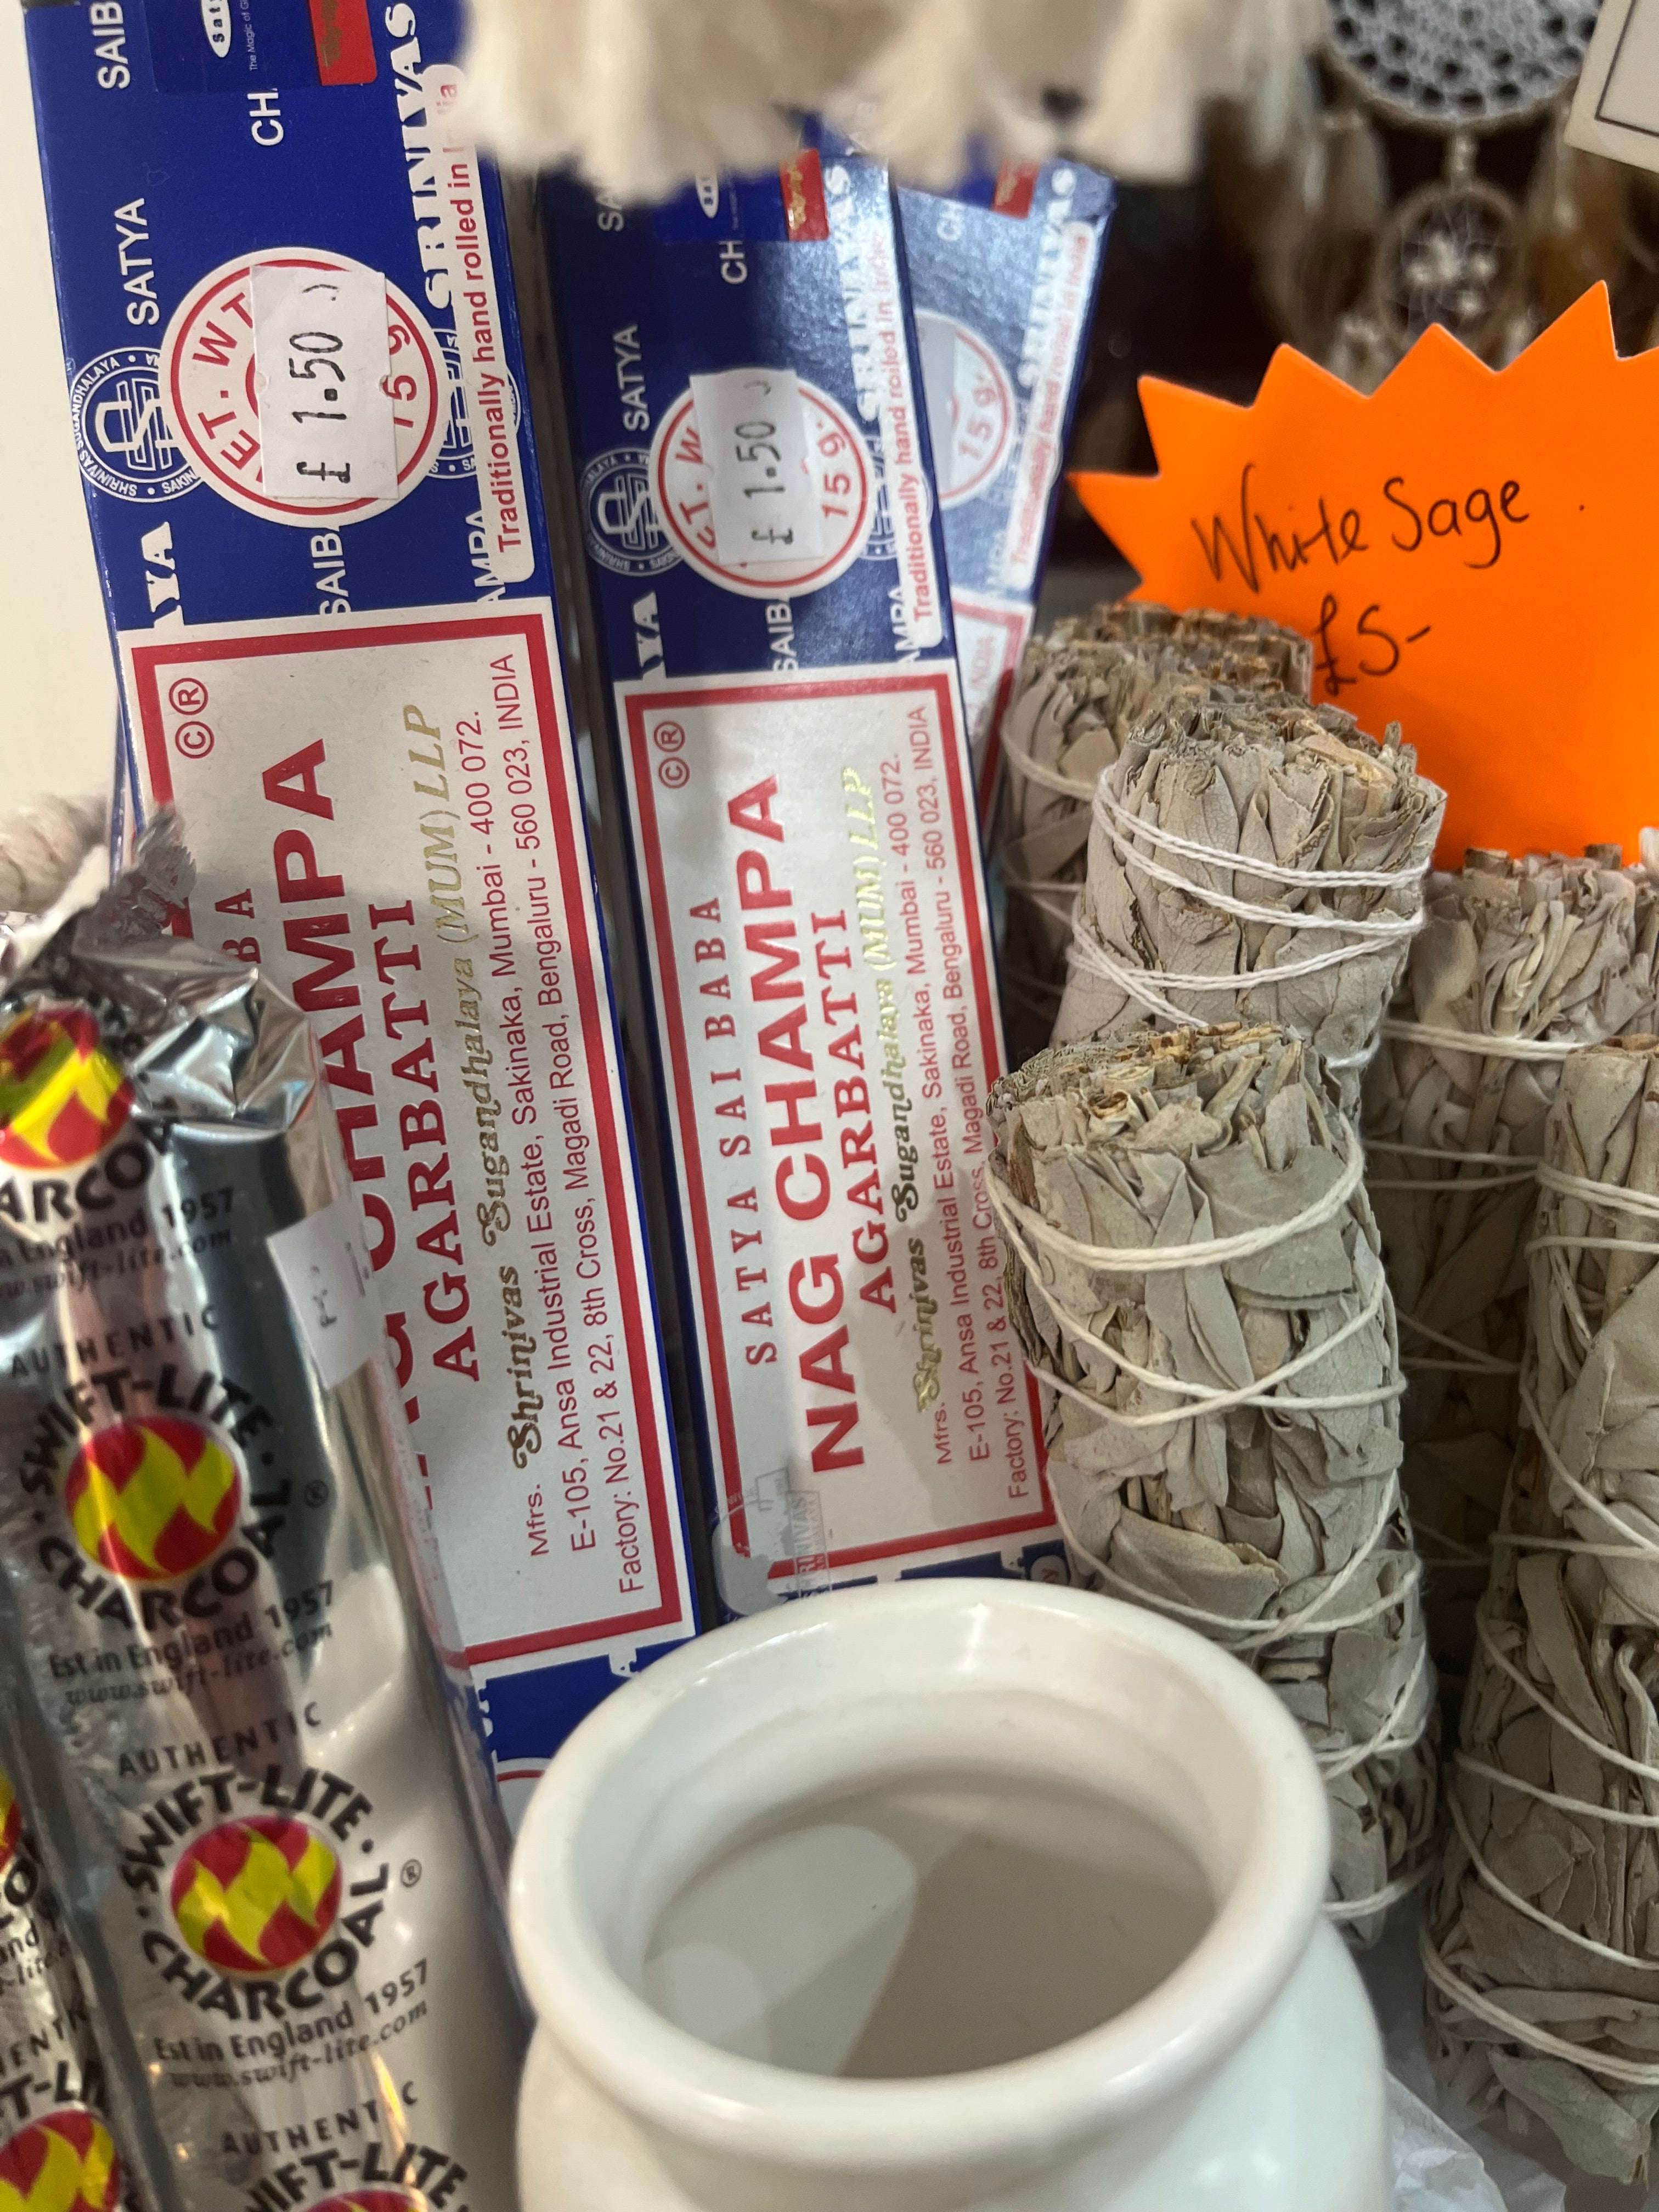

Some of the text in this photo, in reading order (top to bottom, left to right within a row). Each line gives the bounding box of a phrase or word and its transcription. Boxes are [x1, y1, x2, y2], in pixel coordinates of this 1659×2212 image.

[208, 0, 225, 43] Sat
[245, 24, 256, 53] Magic
[250, 52, 258, 71] The
[247, 89, 284, 146] CH
[115, 198, 160, 325] SATYA
[439, 84, 521, 552] Traditionally hand rolled in Iia
[289, 331, 348, 424] 1.50
[612, 324, 651, 432] SATYA
[78, 449, 138, 497] SHRINIVAS
[198, 390, 262, 482] ET.
[675, 426, 704, 465] W
[735, 420, 786, 499] 1.50
[887, 406, 912, 466] hand
[957, 417, 994, 461] 15
[161, 469, 199, 495] SAKIN
[821, 474, 852, 519] 15
[898, 473, 934, 622] Traditionally
[1190, 462, 1531, 594] White Sage
[311, 527, 352, 616] SAIB
[765, 599, 799, 672] SAIB
[489, 653, 524, 730] INDIA
[456, 711, 487, 772] 072.
[503, 740, 533, 795] 023,
[907, 704, 933, 771] INDIA
[465, 782, 495, 835] 400
[841, 766, 878, 850] LLP
[880, 753, 905, 804] 072.
[511, 803, 540, 850] 560
[886, 812, 910, 857] 400
[922, 830, 946, 871] 560
[214, 888, 262, 964] BA
[476, 865, 517, 977] Mumbai
[527, 877, 563, 1007] Bengaluru
[895, 880, 926, 975] Mumbai
[934, 890, 964, 1001] Bengaluru
[500, 987, 537, 1125] Sakinaka,
[541, 1014, 575, 1090] Road,
[913, 982, 942, 1099] Sakinaka,
[947, 1005, 972, 1070] Road,
[403, 704, 549, 1557] Mfrs. Shrinivas Sugandhalaya (MUM) LLP
[690, 898, 778, 1366] SATYA SAI BABA
[727, 774, 866, 1474] NAG CHAMPA
[811, 909, 897, 1314] AGARBATTI
[876, 978, 919, 1223] Sugandhalaya
[954, 1074, 984, 1154] Magadi
[369, 900, 480, 1383] AGARBATTI
[552, 1097, 590, 1191] Magadi
[929, 1107, 955, 1190] Estate,
[163, 1186, 234, 1228] 1957
[521, 1135, 554, 1233] Estate,
[972, 1159, 993, 1231] Cross,
[574, 1198, 601, 1279] Cross,
[938, 1197, 969, 1307] Industrial
[975, 1236, 999, 1270] 8th
[531, 1242, 571, 1370] Industrial
[581, 1286, 608, 1327] 8th
[981, 1276, 1005, 1311] 22,
[987, 1315, 1007, 1333] &
[11, 1307, 219, 1379] AUTHENTIC
[587, 1333, 616, 1375] 22,
[956, 1313, 979, 1374] Ansa
[989, 1341, 1017, 1406] No.21
[556, 1378, 583, 1450] Ansa
[593, 1380, 618, 1399] &
[962, 1381, 991, 1462] E-105,
[19, 1362, 275, 1496] SWIFT-LITE
[596, 1410, 629, 1485] No.21
[934, 1402, 952, 1465] Mfrs.
[1003, 1410, 1030, 1499] Factory:
[562, 1457, 596, 1552] E-105,
[614, 1491, 645, 1594] Factory:
[38, 1479, 294, 1631] CHARCOAL
[127, 1611, 254, 1672] England
[266, 1579, 334, 1629] 1957
[118, 1701, 322, 1778] AUTHENTIC
[122, 1764, 374, 1895] SWIFT-LITE
[140, 1861, 390, 2022] CHARCOAL
[154, 1957, 428, 2062] Est in England 1957
[221, 2080, 418, 2155] AUTHENTC
[248, 2141, 469, 2212] IFT-LITE
